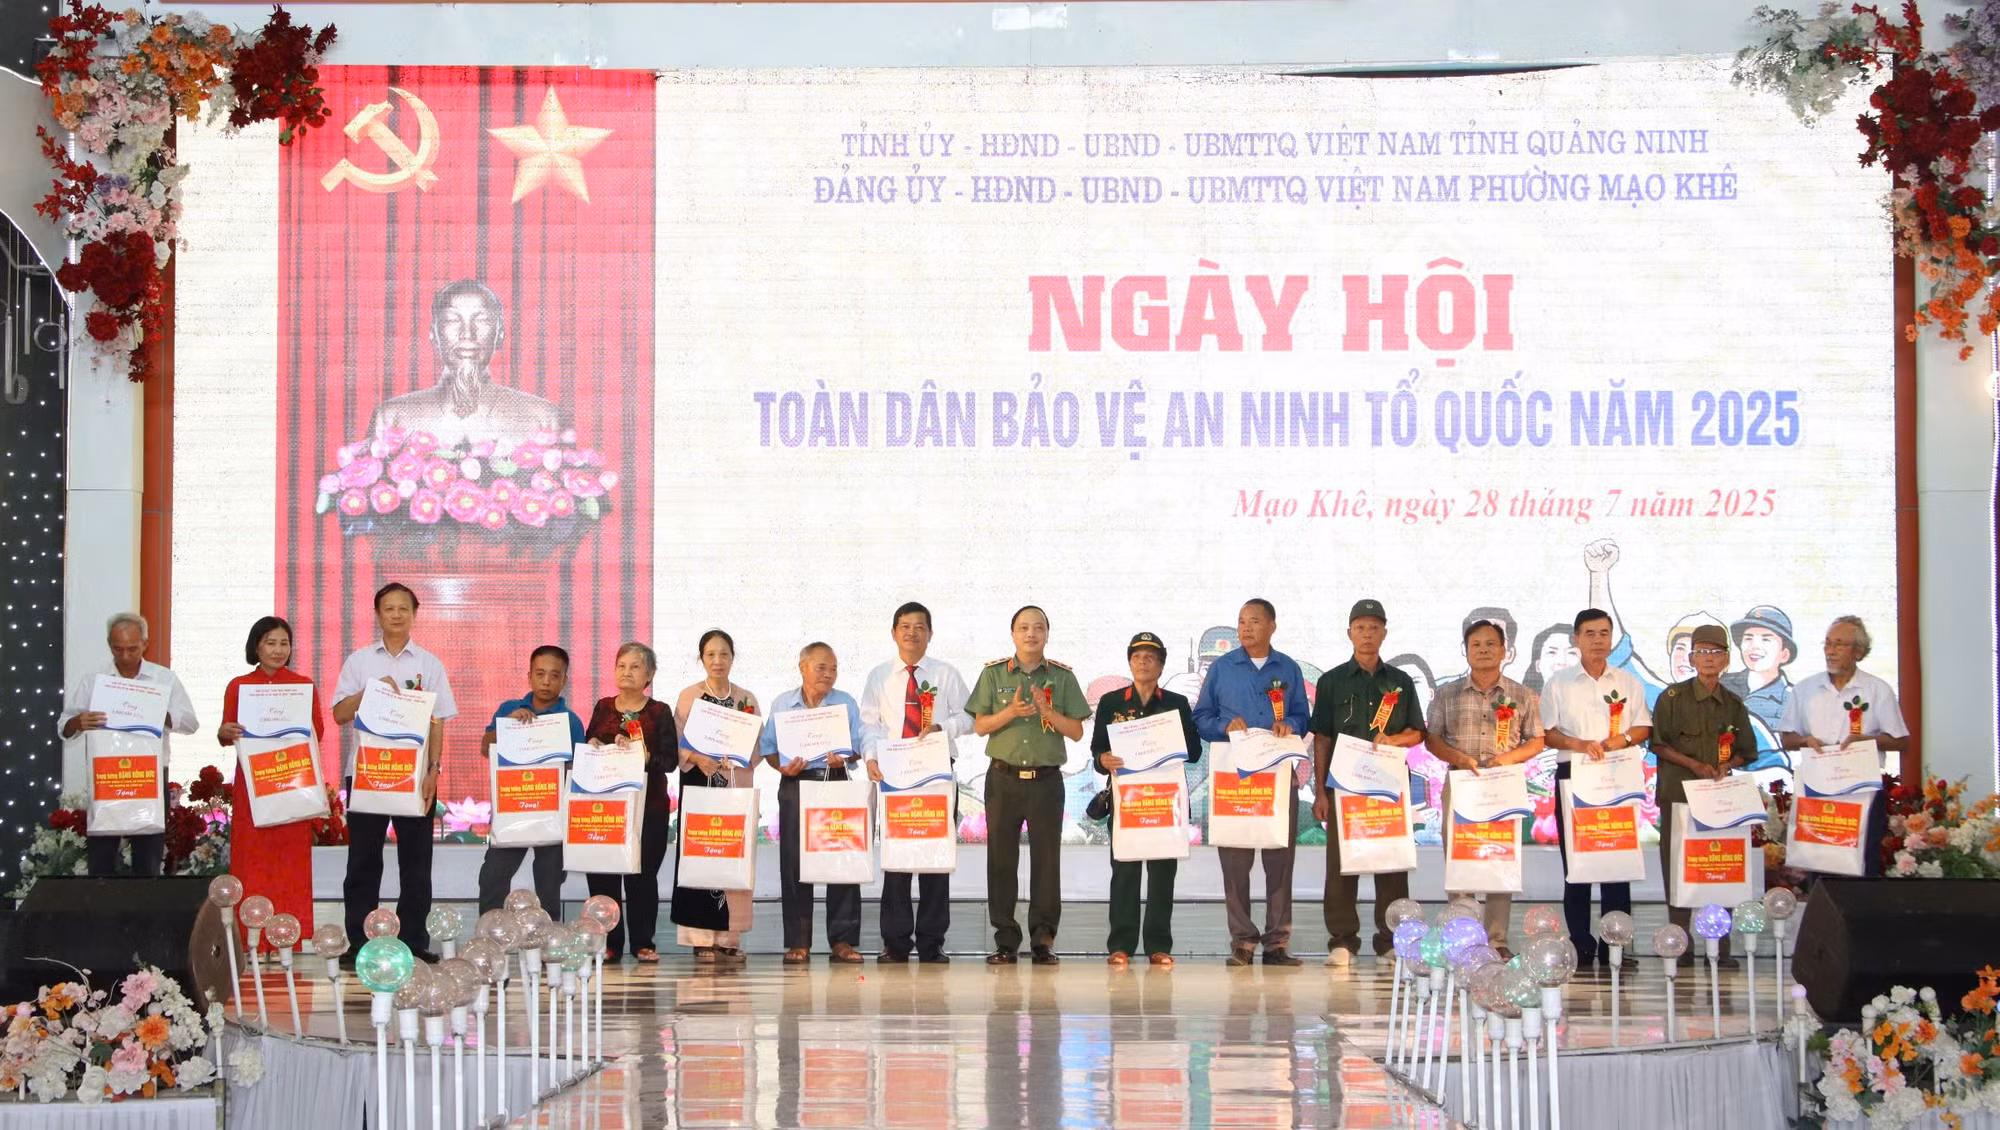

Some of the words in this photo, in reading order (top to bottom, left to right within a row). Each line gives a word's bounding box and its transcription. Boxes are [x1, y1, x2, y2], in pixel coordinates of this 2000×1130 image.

[842, 121, 909, 157] TỈNH
[918, 121, 955, 157] ỦY
[980, 132, 1060, 157] HĐND
[1084, 132, 1161, 157] UBND
[1184, 131, 1299, 158] UBMTTQ
[1305, 123, 1370, 162] VIỆT
[1377, 130, 1441, 156] NAM
[1450, 119, 1518, 155] TỈNH
[1526, 118, 1626, 157] QUẢNG
[1634, 129, 1709, 154] NINH
[813, 163, 898, 205] ĐẢNG
[905, 163, 946, 204] ỦY
[971, 175, 1057, 203] HĐND
[1082, 175, 1163, 203] UBND
[1187, 174, 1308, 204] UBMTTQ
[1315, 166, 1383, 210] VIỆT
[1392, 174, 1460, 201] NAM
[1468, 165, 1591, 202] PHƯỜNG
[1598, 173, 1666, 209] MẠO
[1674, 163, 1738, 200] KHÊ
[1028, 257, 1309, 352] NGÀY
[1342, 256, 1514, 367] HỘI
[753, 378, 869, 447] TOÀN
[886, 378, 976, 447] DÂN
[992, 371, 1080, 447] BẢO
[1095, 376, 1147, 460] VỆ
[1162, 391, 1224, 447] AN
[1240, 391, 1349, 447] NINH
[1364, 368, 1420, 447] TỔ
[1434, 370, 1553, 453] QUỐC
[1569, 378, 1674, 446] NĂM
[1690, 390, 1799, 446] 2025
[1231, 489, 1299, 525] Mạo
[1305, 489, 1374, 521] Khê,
[1385, 492, 1455, 524] ngày
[1463, 489, 1500, 518] 28
[1508, 489, 1594, 524] tháng
[1606, 489, 1623, 518] 7
[1629, 490, 1696, 518] năm
[1704, 489, 1777, 518] 2025
